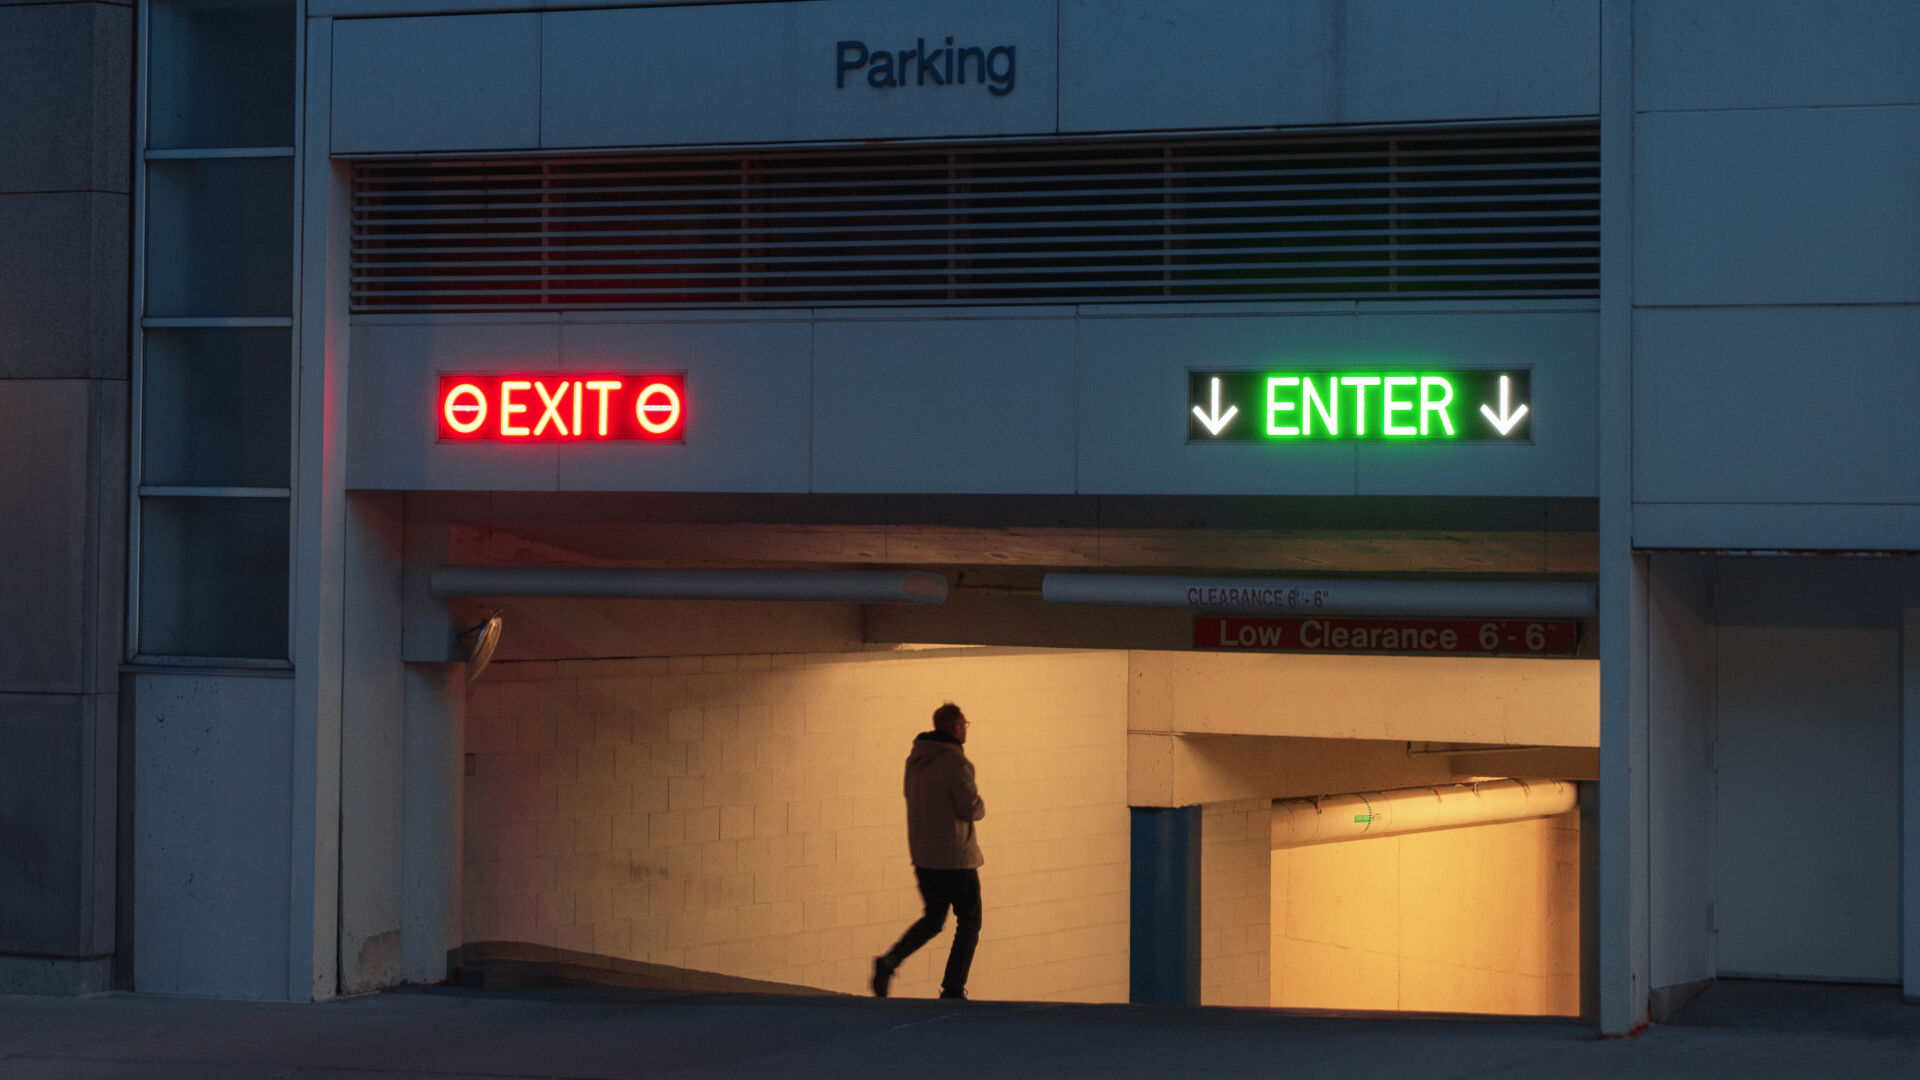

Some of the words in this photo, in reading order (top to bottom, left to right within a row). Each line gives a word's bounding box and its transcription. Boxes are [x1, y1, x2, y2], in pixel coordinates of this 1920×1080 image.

[836, 36, 1016, 97] Parking
[501, 380, 622, 436] EXIT
[1265, 375, 1456, 436] ENTER
[1187, 587, 1283, 607] CLEARANCE
[1219, 619, 1283, 647] Low
[1299, 619, 1458, 649] Clearance
